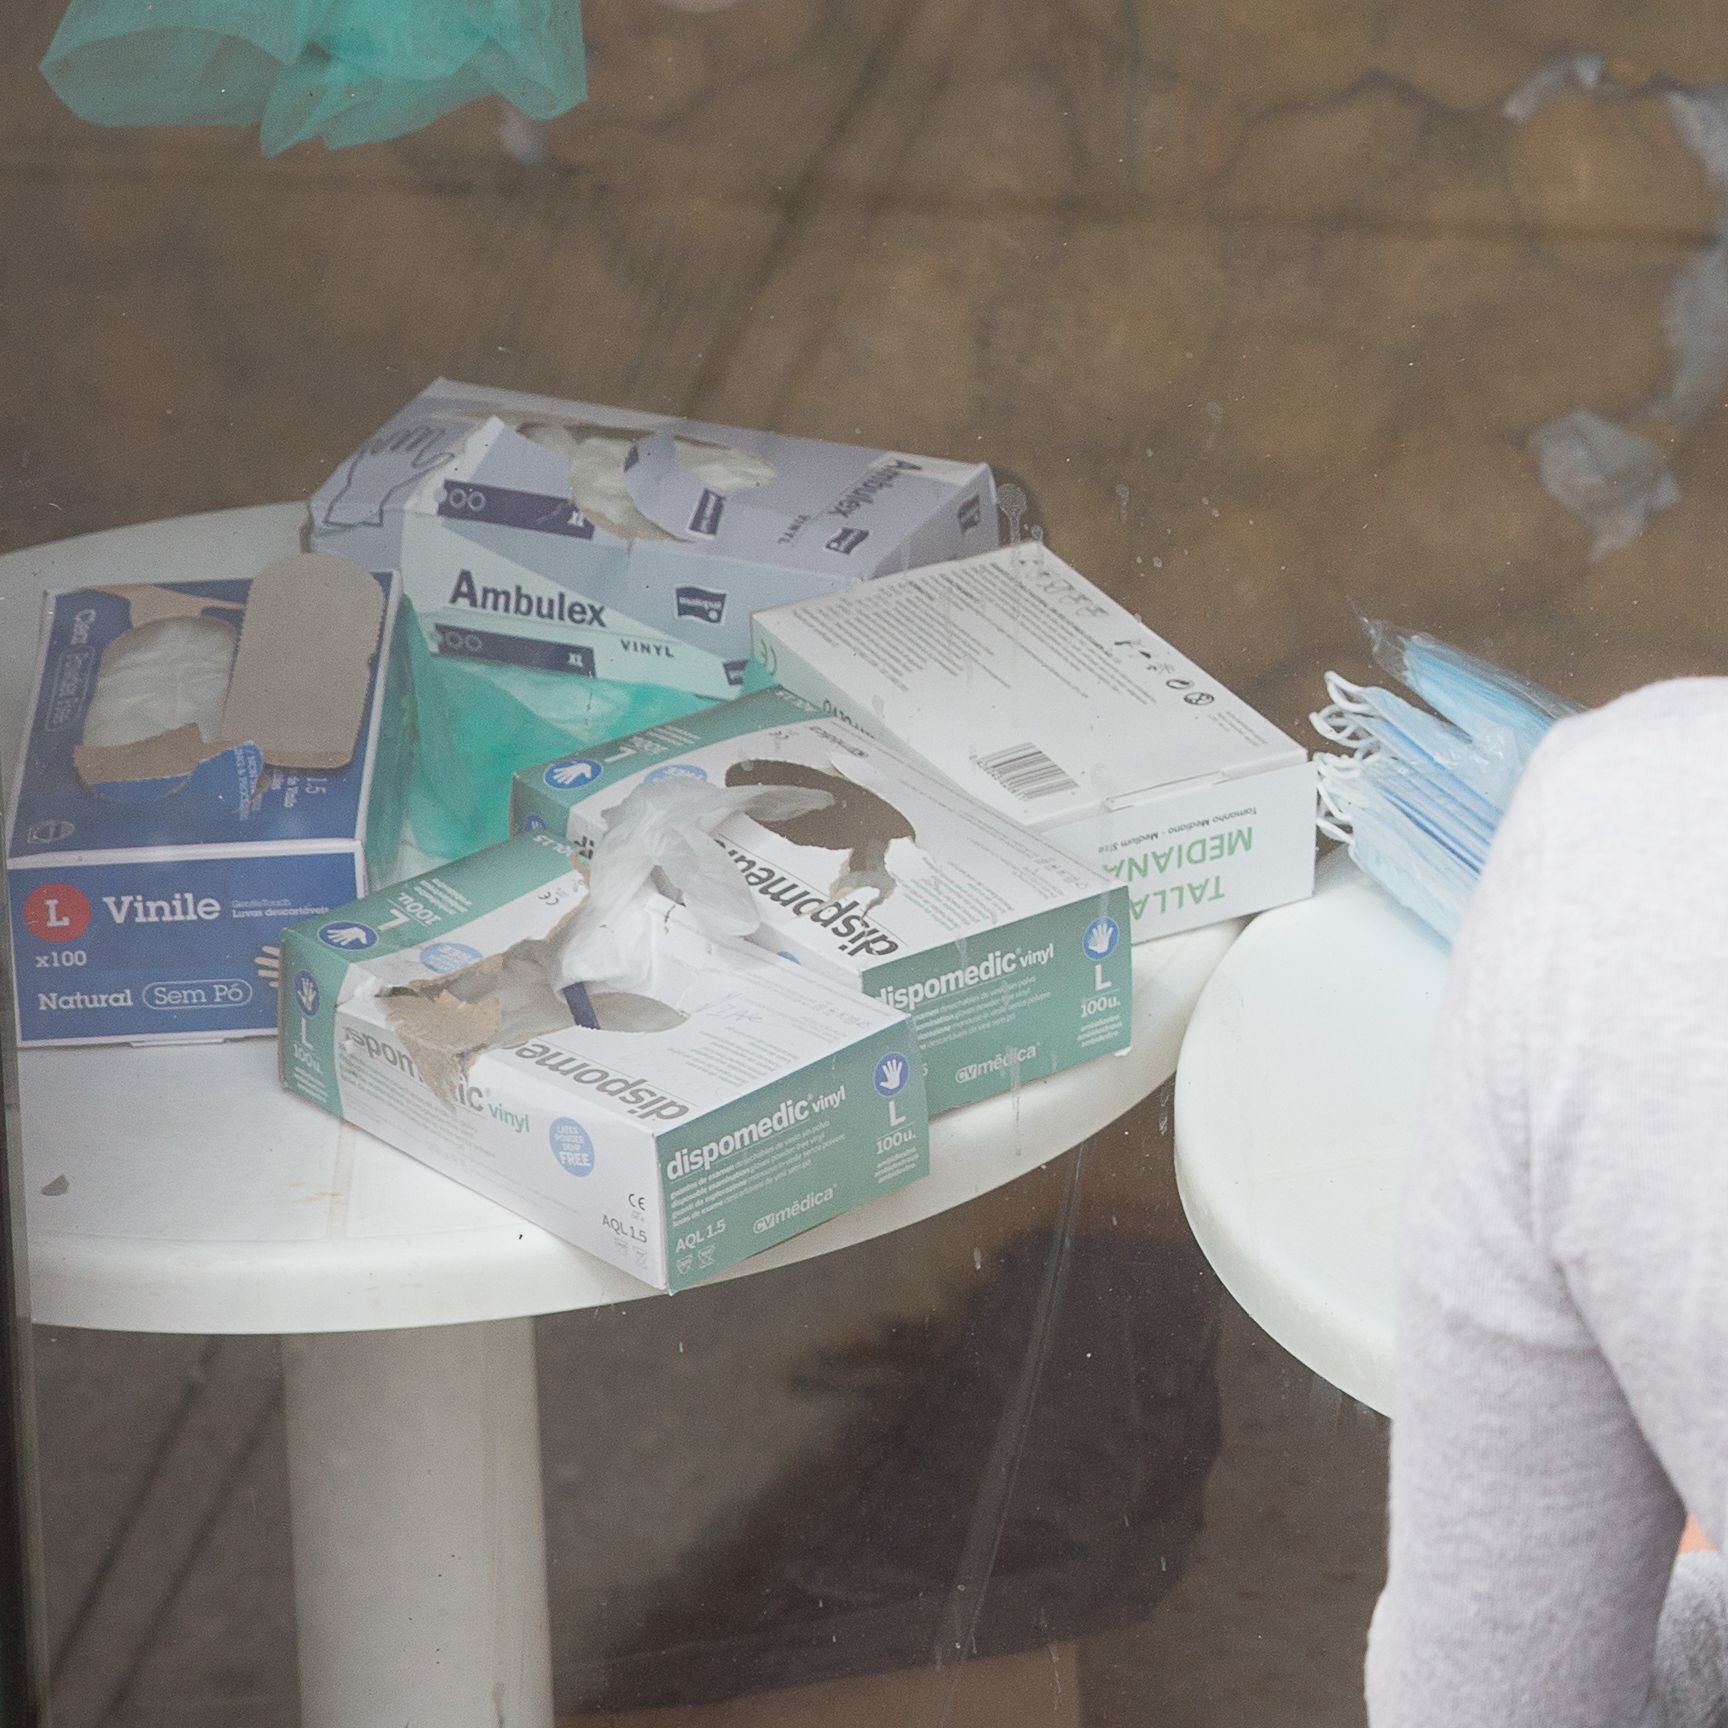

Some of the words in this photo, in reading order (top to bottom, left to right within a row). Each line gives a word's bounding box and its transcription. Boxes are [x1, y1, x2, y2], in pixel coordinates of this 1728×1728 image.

[451, 569, 607, 627] Ambulex
[620, 639, 675, 658] VINYL
[1168, 820, 1210, 834] Mediano
[1216, 807, 1257, 822] Tamanho
[1121, 832, 1159, 846] Medium
[103, 893, 221, 923] Vinile
[1130, 875, 1225, 921] TALLA
[46, 899, 69, 927] L
[232, 907, 262, 919] Luvas
[36, 950, 86, 968] x100
[1019, 943, 1054, 968] vinyl
[1096, 964, 1112, 992] L
[38, 990, 133, 1011] Natural
[154, 987, 205, 1005] Sem
[214, 984, 243, 1003] Pó
[1081, 997, 1120, 1018] 100u.
[489, 1102, 530, 1133] vinyl
[889, 1101, 906, 1126] L
[666, 1099, 809, 1181] dispomedic
[812, 1085, 846, 1113] vinyl
[876, 1130, 916, 1154] 100u.
[559, 1152, 591, 1167] FREE
[602, 1215, 627, 1236] AQL
[630, 1225, 648, 1243] 1.5
[675, 1230, 704, 1253] AQL
[707, 1219, 726, 1238] 1.5
